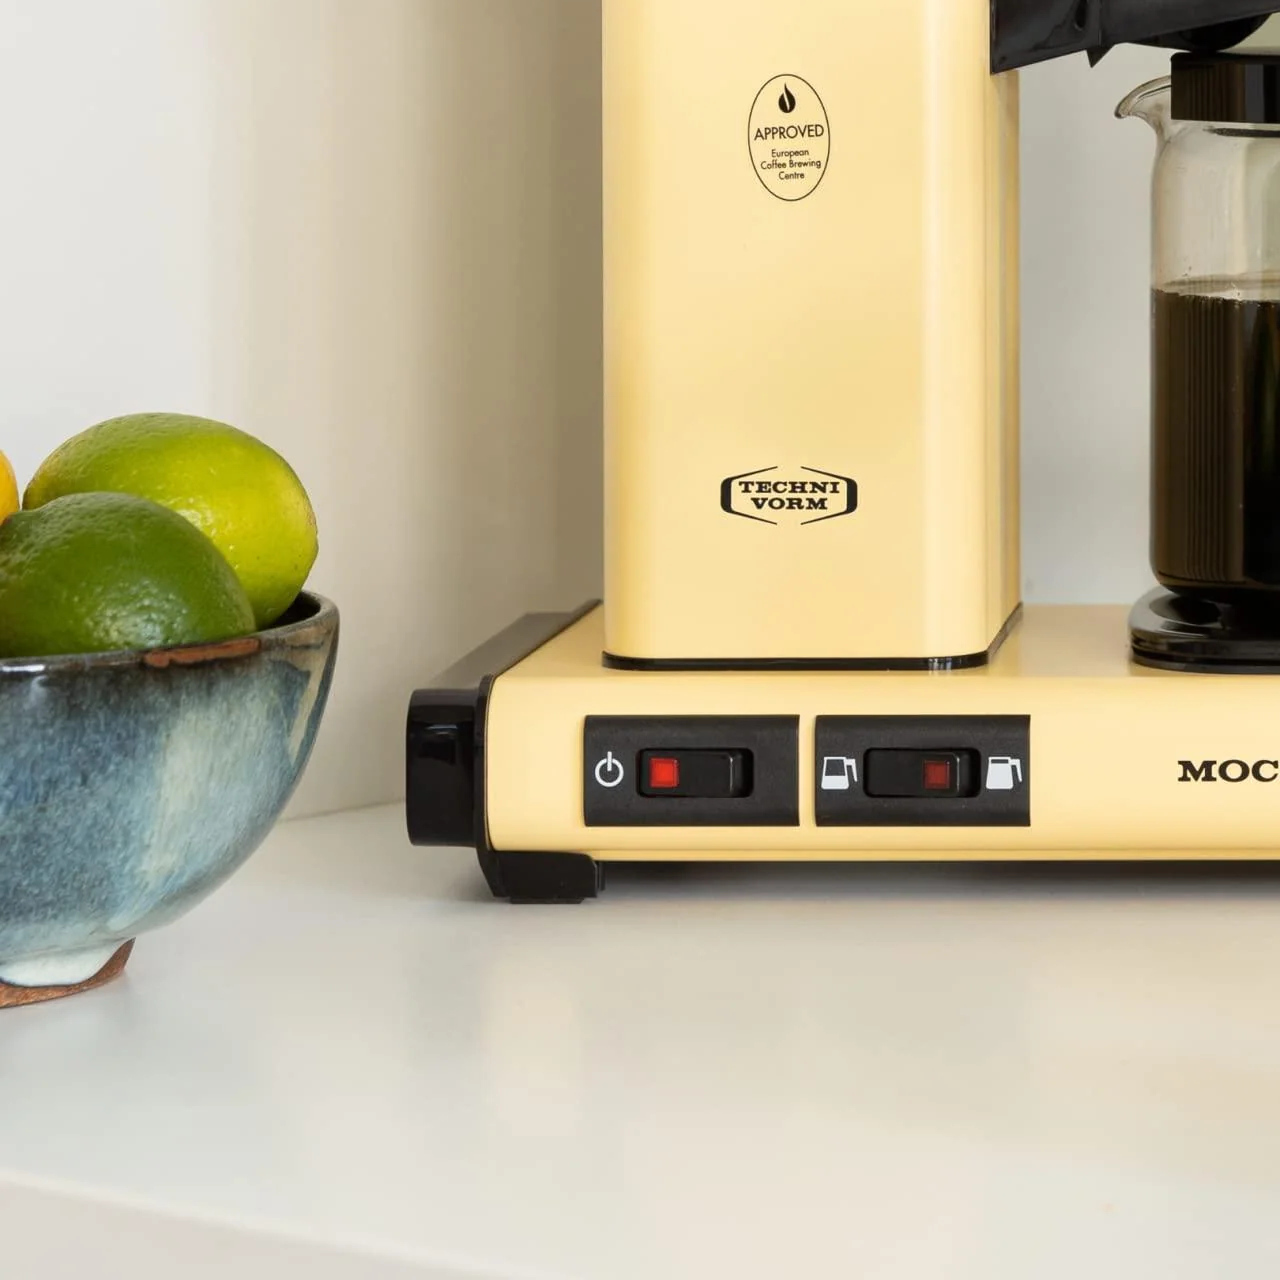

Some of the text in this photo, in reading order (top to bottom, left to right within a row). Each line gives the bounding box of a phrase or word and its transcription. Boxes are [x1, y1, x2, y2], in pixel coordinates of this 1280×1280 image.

[754, 124, 825, 141] APPROVED
[771, 148, 810, 158] European
[760, 158, 822, 170] Coffee Brewing
[778, 170, 805, 181] Centre
[738, 481, 840, 494] TECHNI
[750, 497, 828, 510] VORM
